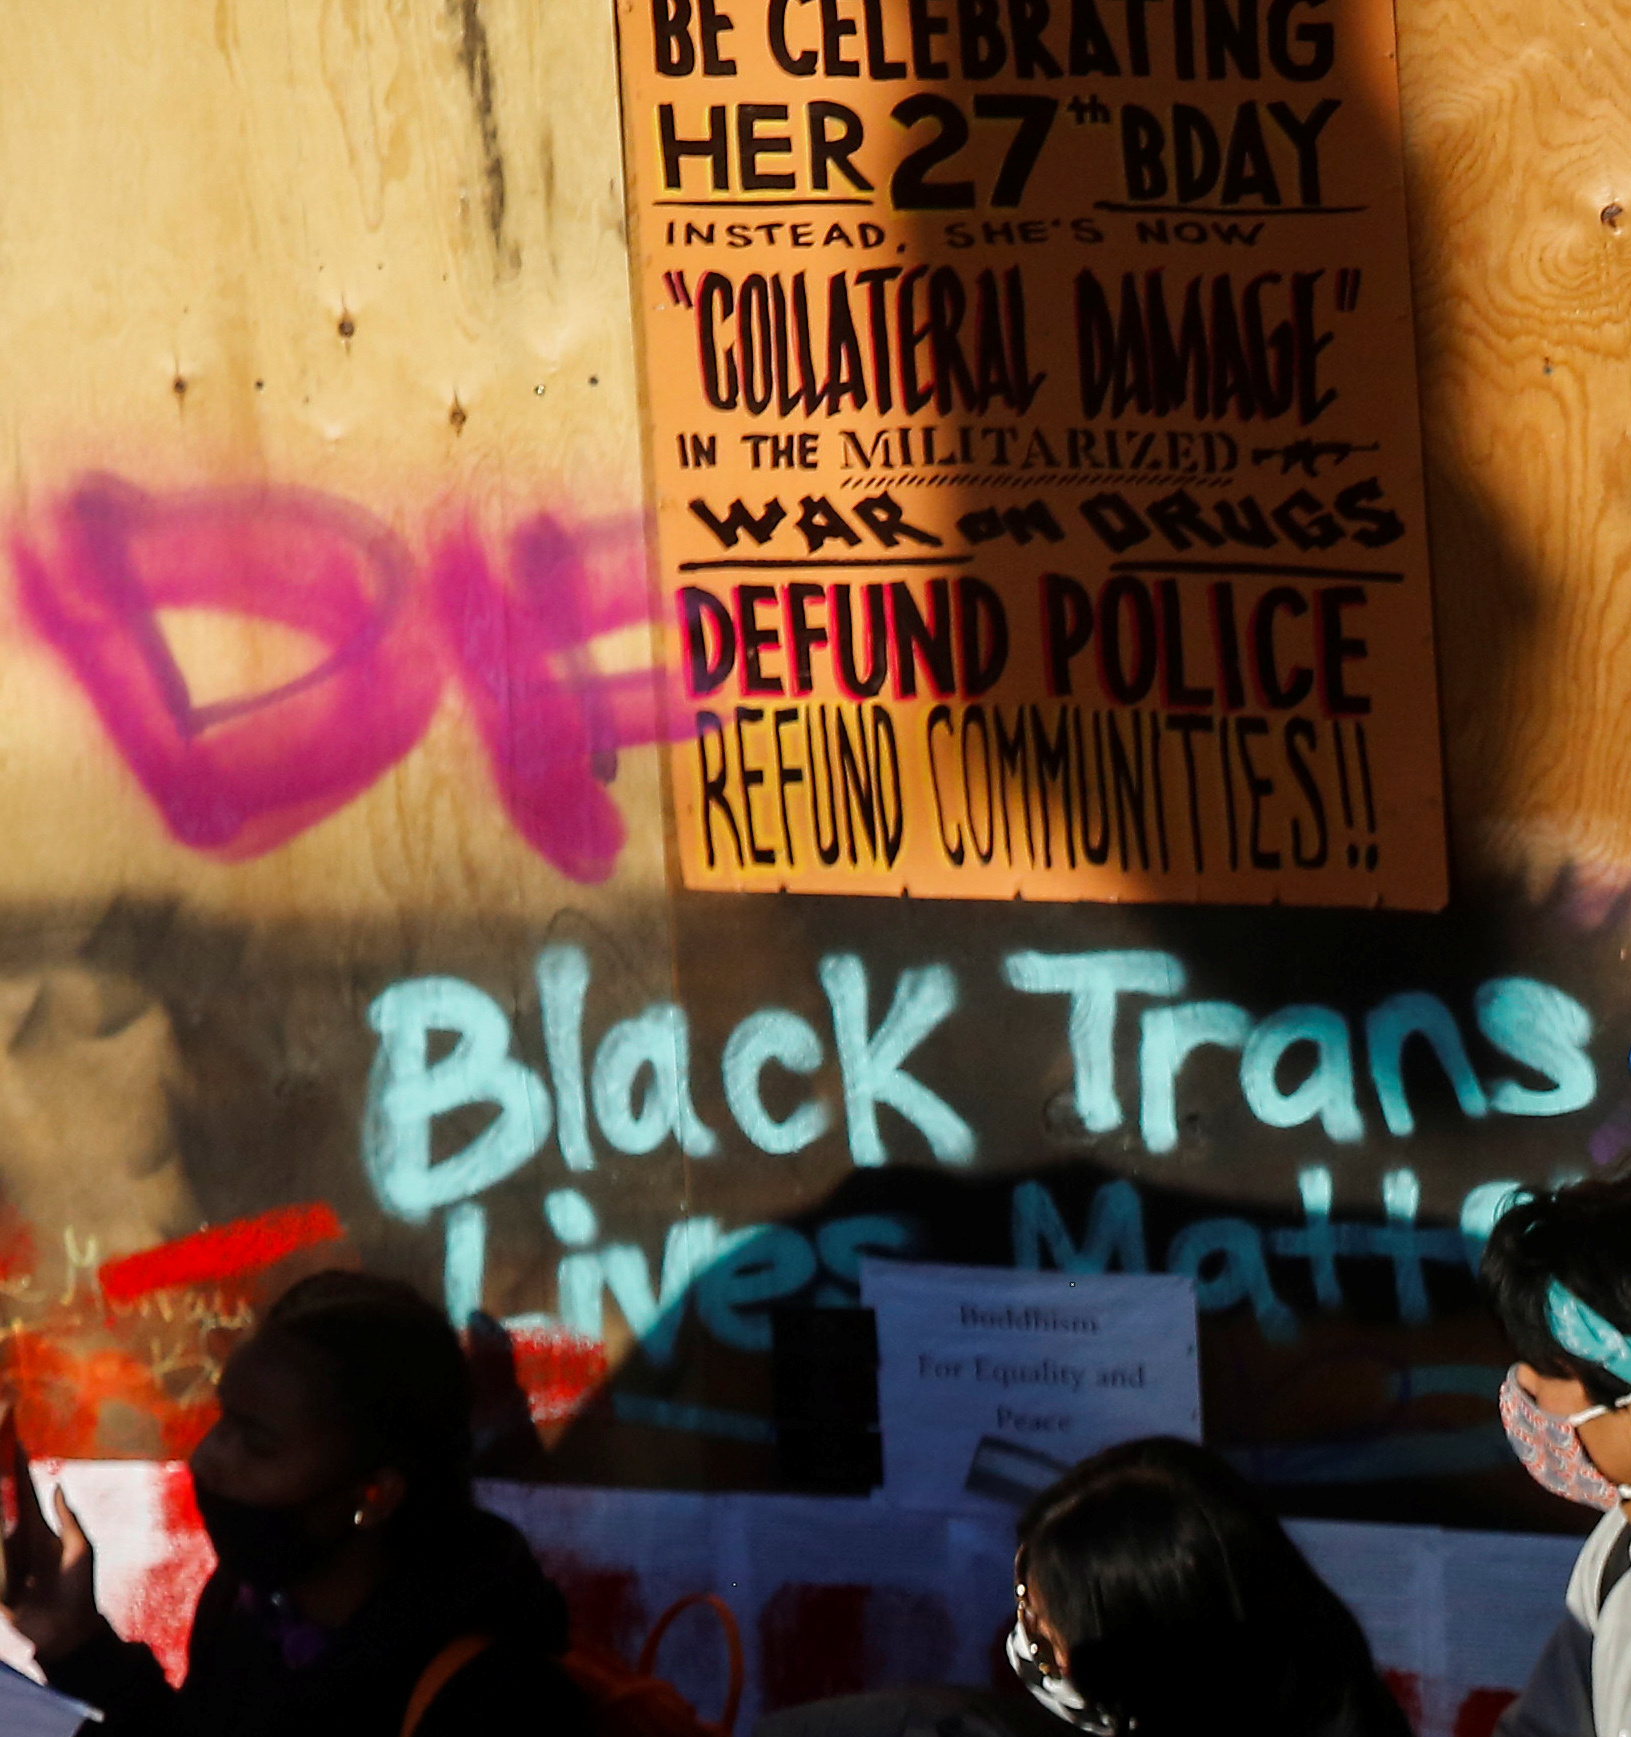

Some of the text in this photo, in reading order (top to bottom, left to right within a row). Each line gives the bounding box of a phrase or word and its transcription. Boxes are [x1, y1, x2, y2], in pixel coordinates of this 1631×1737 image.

[654, 0, 1335, 80] BE CELEBRATING
[654, 102, 875, 196] HER
[1119, 98, 1341, 208] BDAY
[944, 216, 1104, 251] SHE'S
[1137, 217, 1266, 249] NOW
[677, 427, 1239, 477] IN THE MILITARIZED
[689, 490, 942, 554] WAR
[1080, 480, 1405, 554] DRUGS
[675, 573, 1374, 718] DEFUND POLICE
[699, 704, 1381, 874] REFUND COMMUNITIES!!
[363, 945, 1599, 1222] Black Trans
[445, 1190, 935, 1362] Lives
[960, 1306, 1098, 1333] Buddhism
[918, 1354, 1146, 1388] For Equality and
[997, 1406, 1072, 1431] Peace
